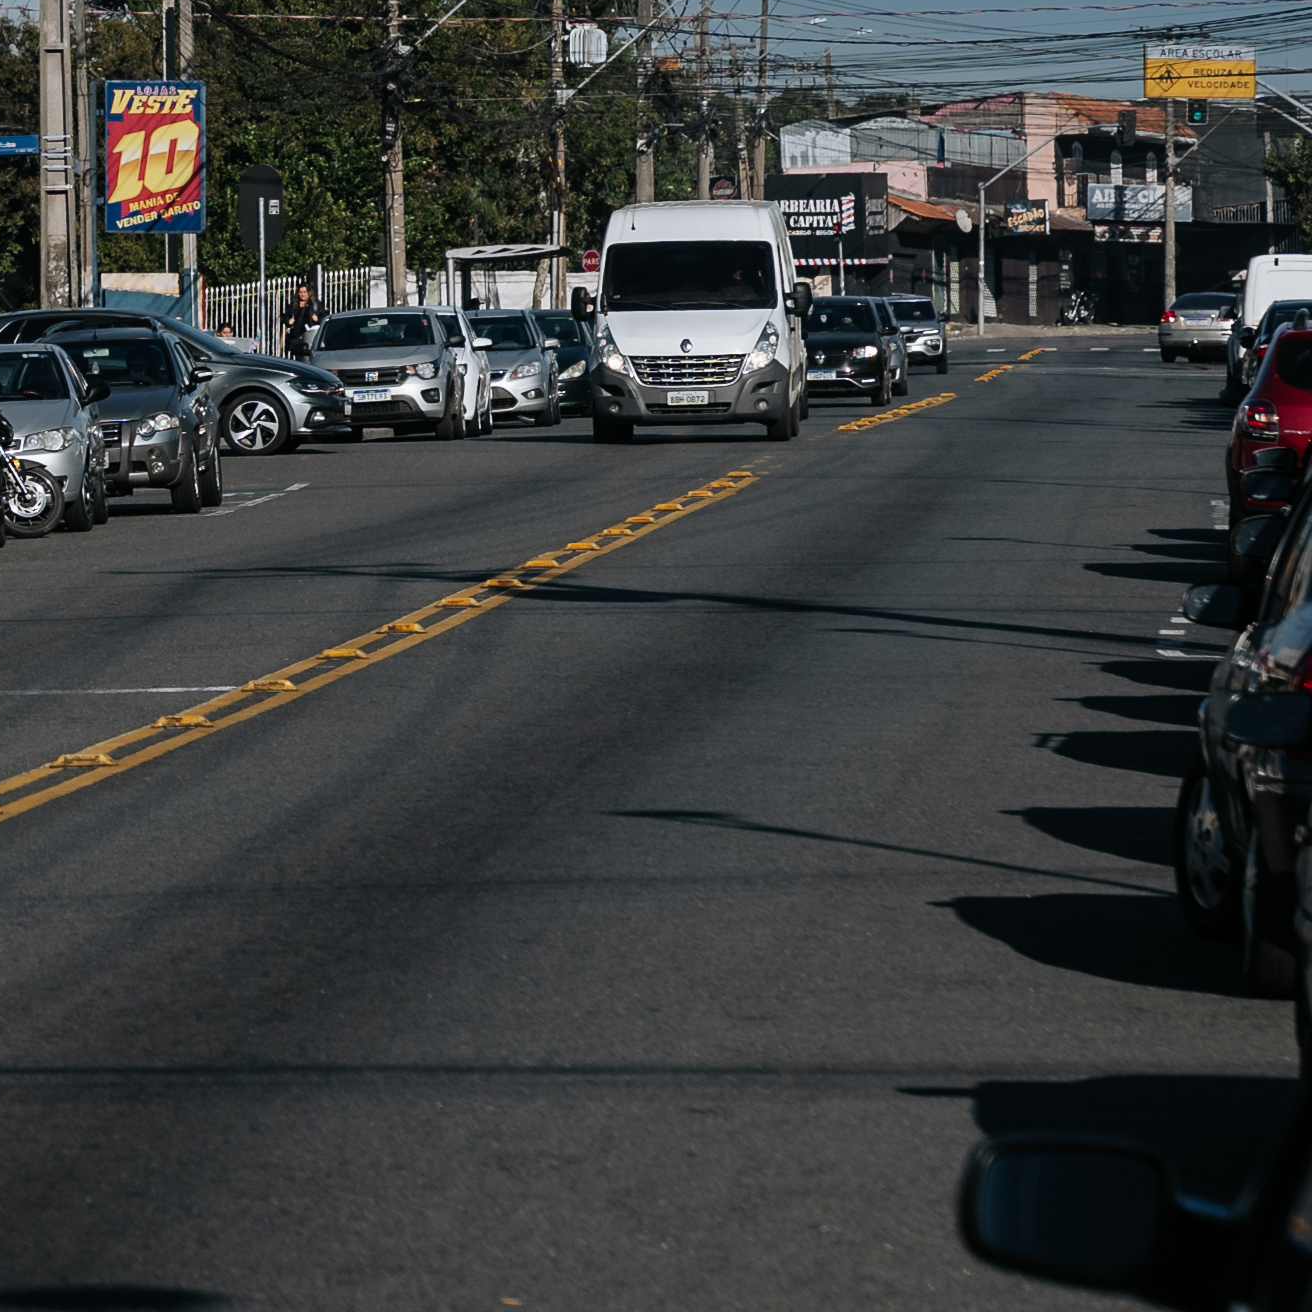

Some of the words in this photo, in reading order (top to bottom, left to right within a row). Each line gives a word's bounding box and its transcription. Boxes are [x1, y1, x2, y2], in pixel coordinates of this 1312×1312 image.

[1192, 49, 1243, 59] ESCOLAR
[1193, 68, 1233, 76] REDUZA
[136, 86, 177, 96] LOJAS
[1187, 80, 1250, 89] VELOCIDADE
[110, 89, 199, 114] VESTE
[108, 119, 200, 204] 10
[128, 197, 166, 213] MANIA
[165, 191, 181, 204] DE
[116, 210, 159, 229] VENDER
[161, 200, 202, 218] BARATO
